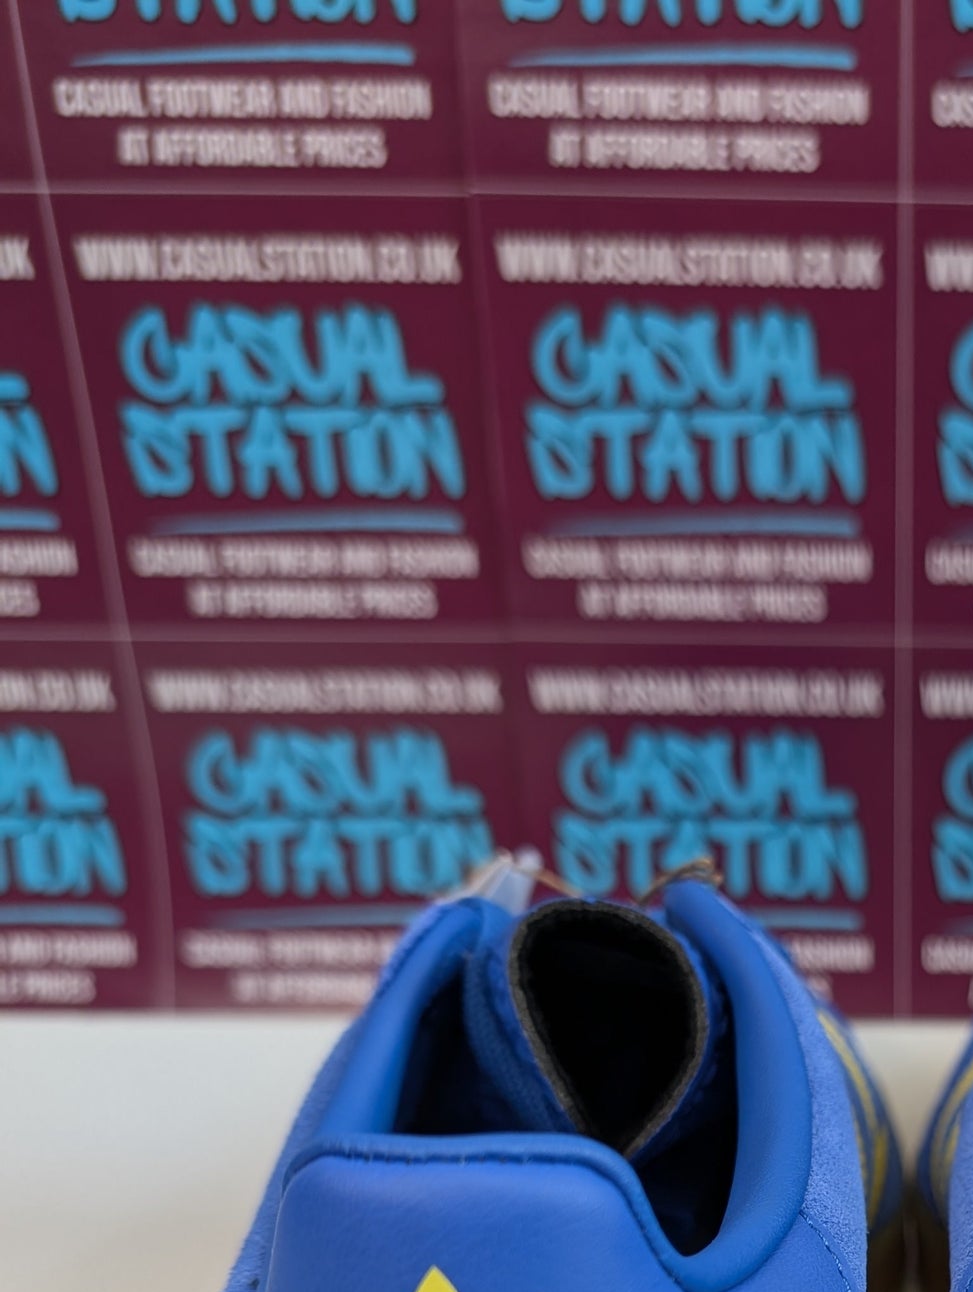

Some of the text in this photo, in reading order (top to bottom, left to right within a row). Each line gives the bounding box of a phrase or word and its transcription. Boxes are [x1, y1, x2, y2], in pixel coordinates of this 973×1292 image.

[119, 302, 443, 405] CASUAL
[531, 308, 852, 409] CASUAL
[119, 402, 465, 498] STATION
[526, 403, 866, 502] STATION
[185, 724, 485, 815] CASUAL
[560, 728, 858, 818] CASUAL
